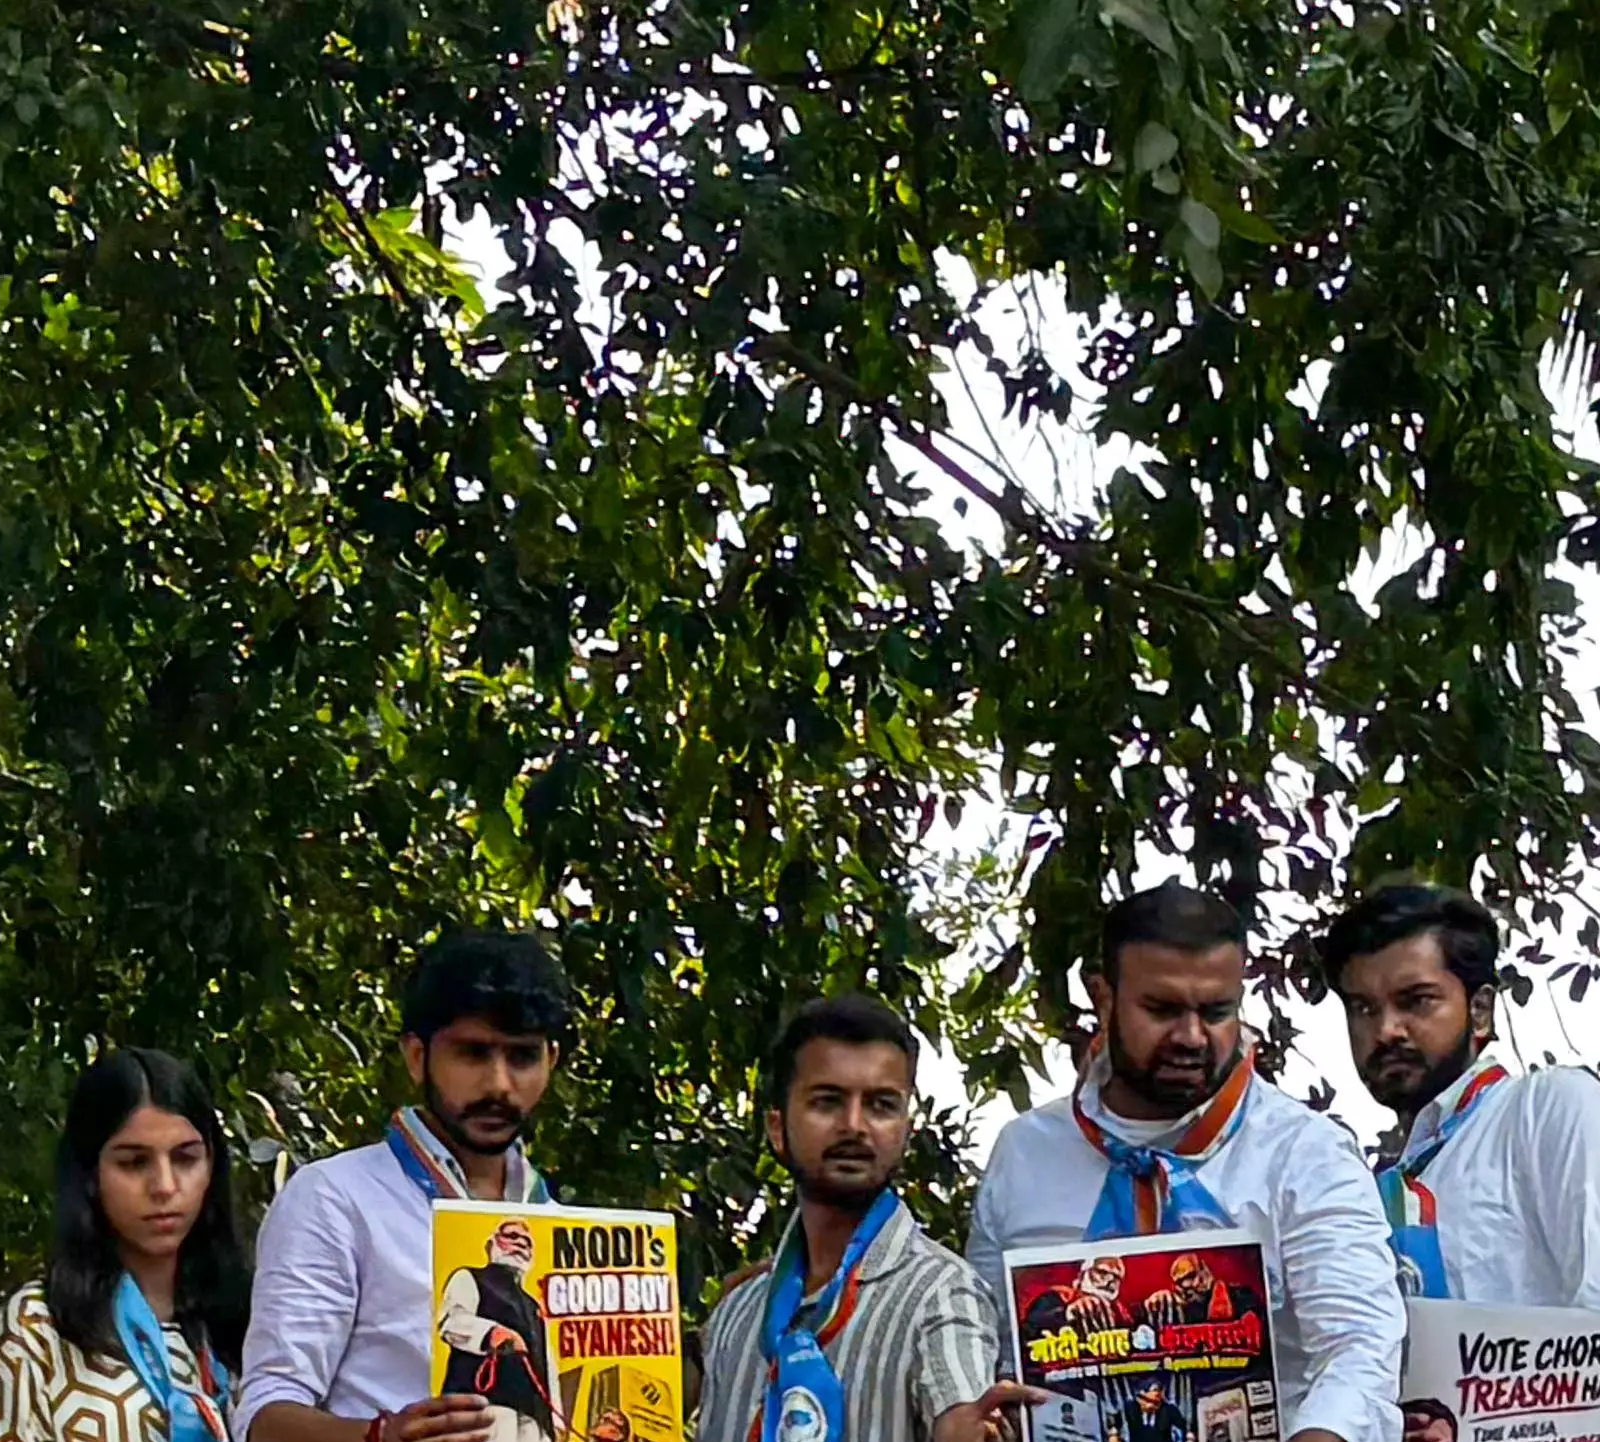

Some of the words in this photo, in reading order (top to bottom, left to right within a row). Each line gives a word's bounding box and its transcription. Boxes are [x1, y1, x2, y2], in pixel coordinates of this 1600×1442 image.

[553, 1224, 665, 1268] MODI's
[548, 1274, 620, 1315] GOOD
[622, 1274, 669, 1312] BOY
[559, 1318, 675, 1358] GYANESH!
[1459, 1332, 1530, 1375] VOTE
[1456, 1370, 1579, 1417] TREASON
